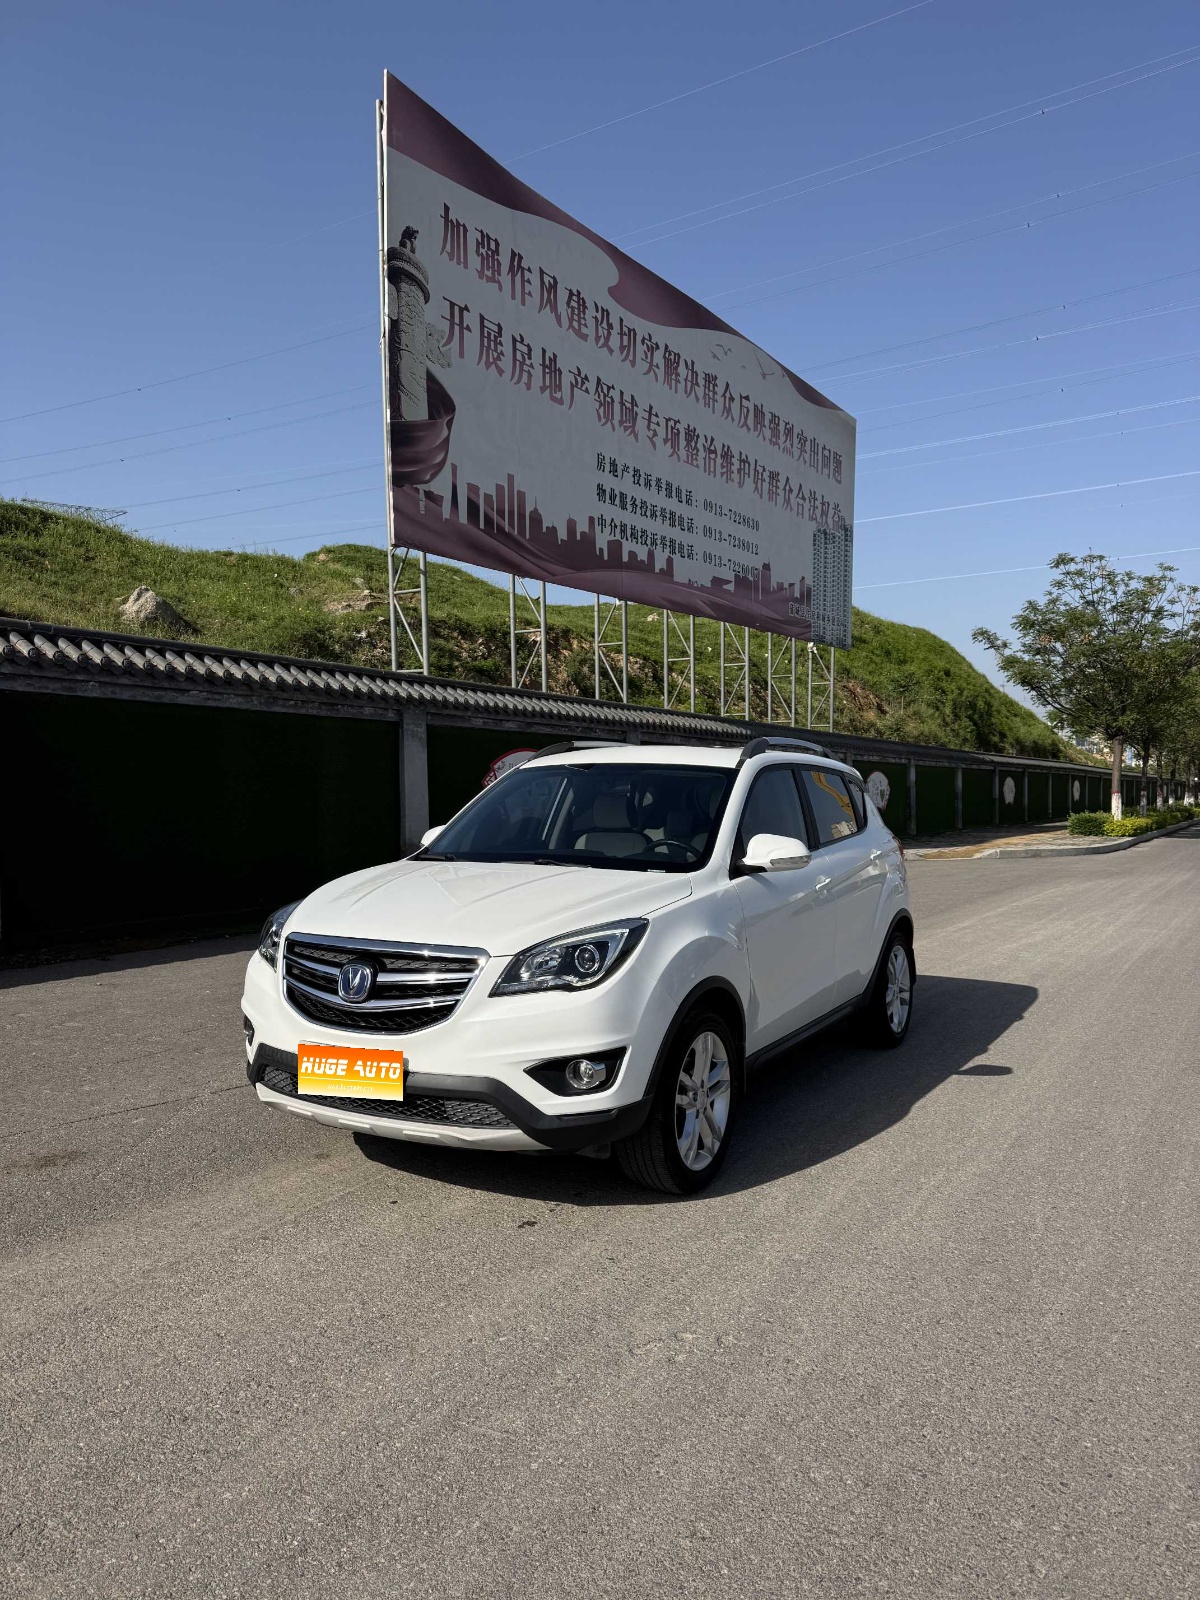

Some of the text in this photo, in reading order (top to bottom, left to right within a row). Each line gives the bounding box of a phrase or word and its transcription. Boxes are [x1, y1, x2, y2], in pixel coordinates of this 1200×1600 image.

[440, 202, 842, 485] 加强作风建设切实解决群众反映强烈突出问题
[441, 296, 842, 533] 开展房地产领域专项整治维护好群众合法权益
